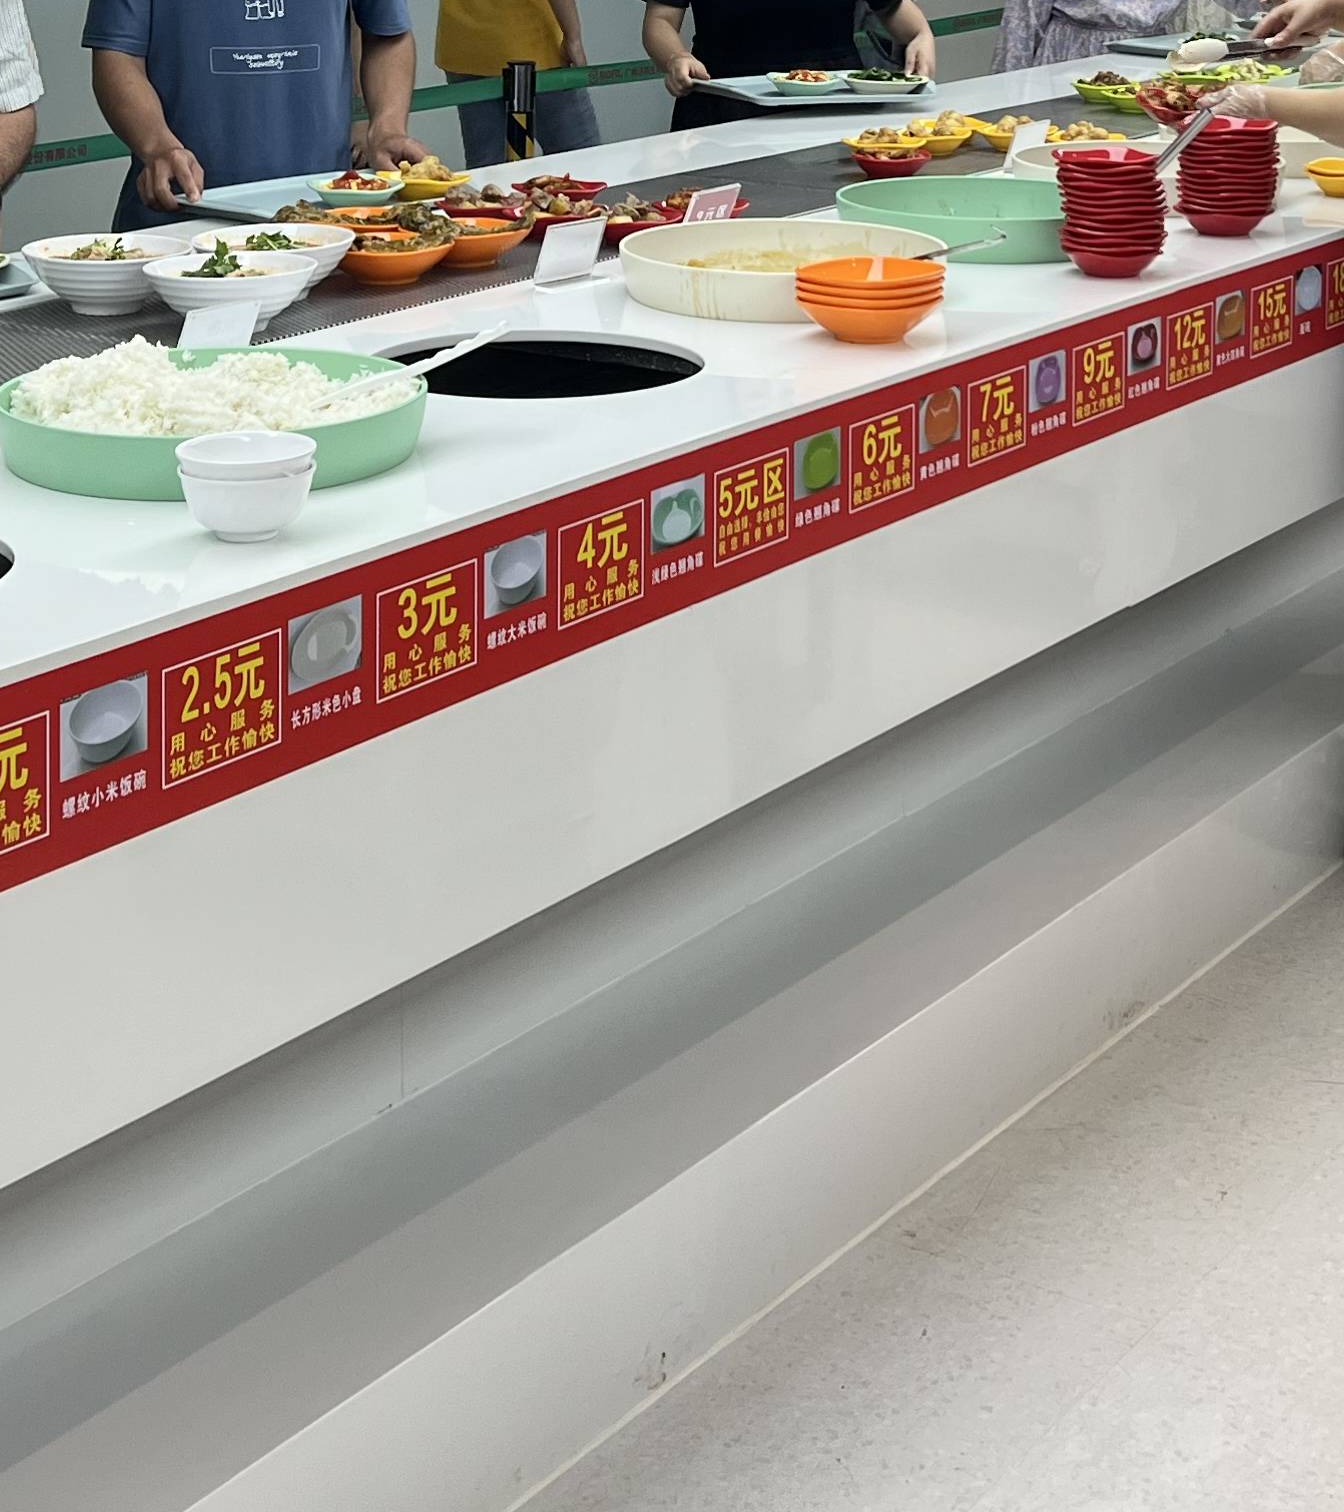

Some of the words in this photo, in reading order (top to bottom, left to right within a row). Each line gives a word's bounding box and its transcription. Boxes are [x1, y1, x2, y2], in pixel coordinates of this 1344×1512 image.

[1258, 284, 1286, 320] 15元
[1174, 310, 1206, 350] 12元
[1083, 341, 1115, 384] 9元
[979, 376, 1014, 423] 7元
[862, 415, 902, 466] 6元
[718, 457, 785, 518] 5元区
[576, 511, 628, 569] 4元
[397, 573, 458, 639] 3元
[563, 578, 639, 622] 祝您工作愉快
[383, 623, 472, 673] 用心服务
[383, 645, 472, 694] 祝您工作愉快
[180, 642, 266, 723] 2.5元
[169, 698, 275, 755] 用心服务
[169, 722, 275, 779] 祝您工作愉快
[61, 769, 147, 819] 螺纹小米饭碗
